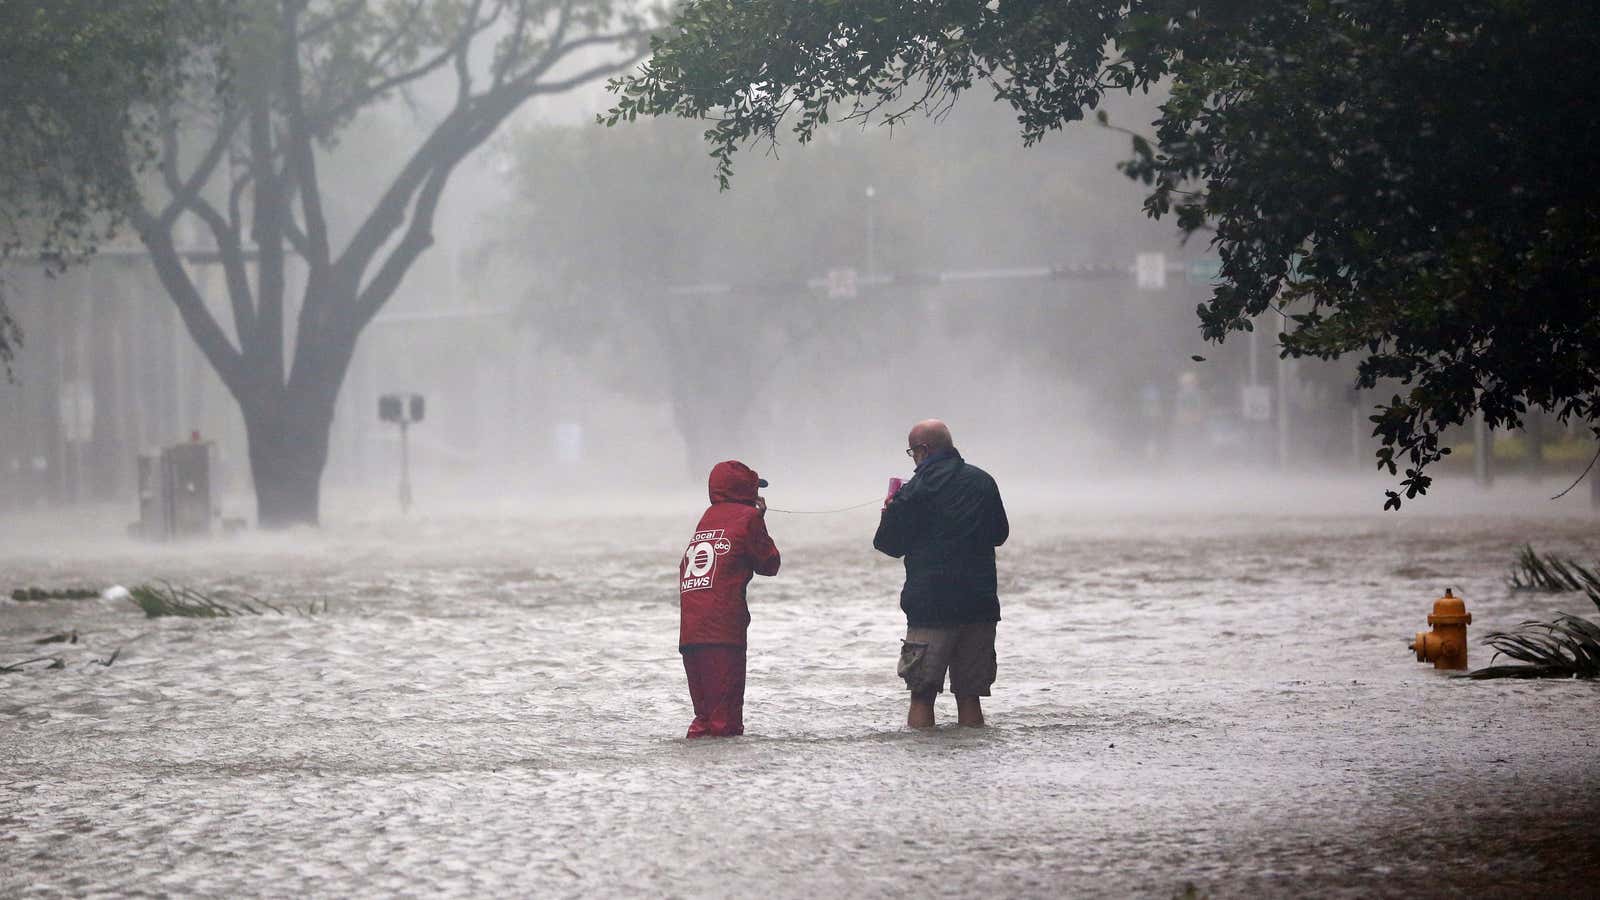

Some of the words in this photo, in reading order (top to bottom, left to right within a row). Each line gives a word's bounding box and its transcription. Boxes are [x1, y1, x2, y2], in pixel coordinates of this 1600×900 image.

[715, 542, 729, 550] abc
[684, 542, 714, 578] 10
[681, 577, 710, 589] NEWS
